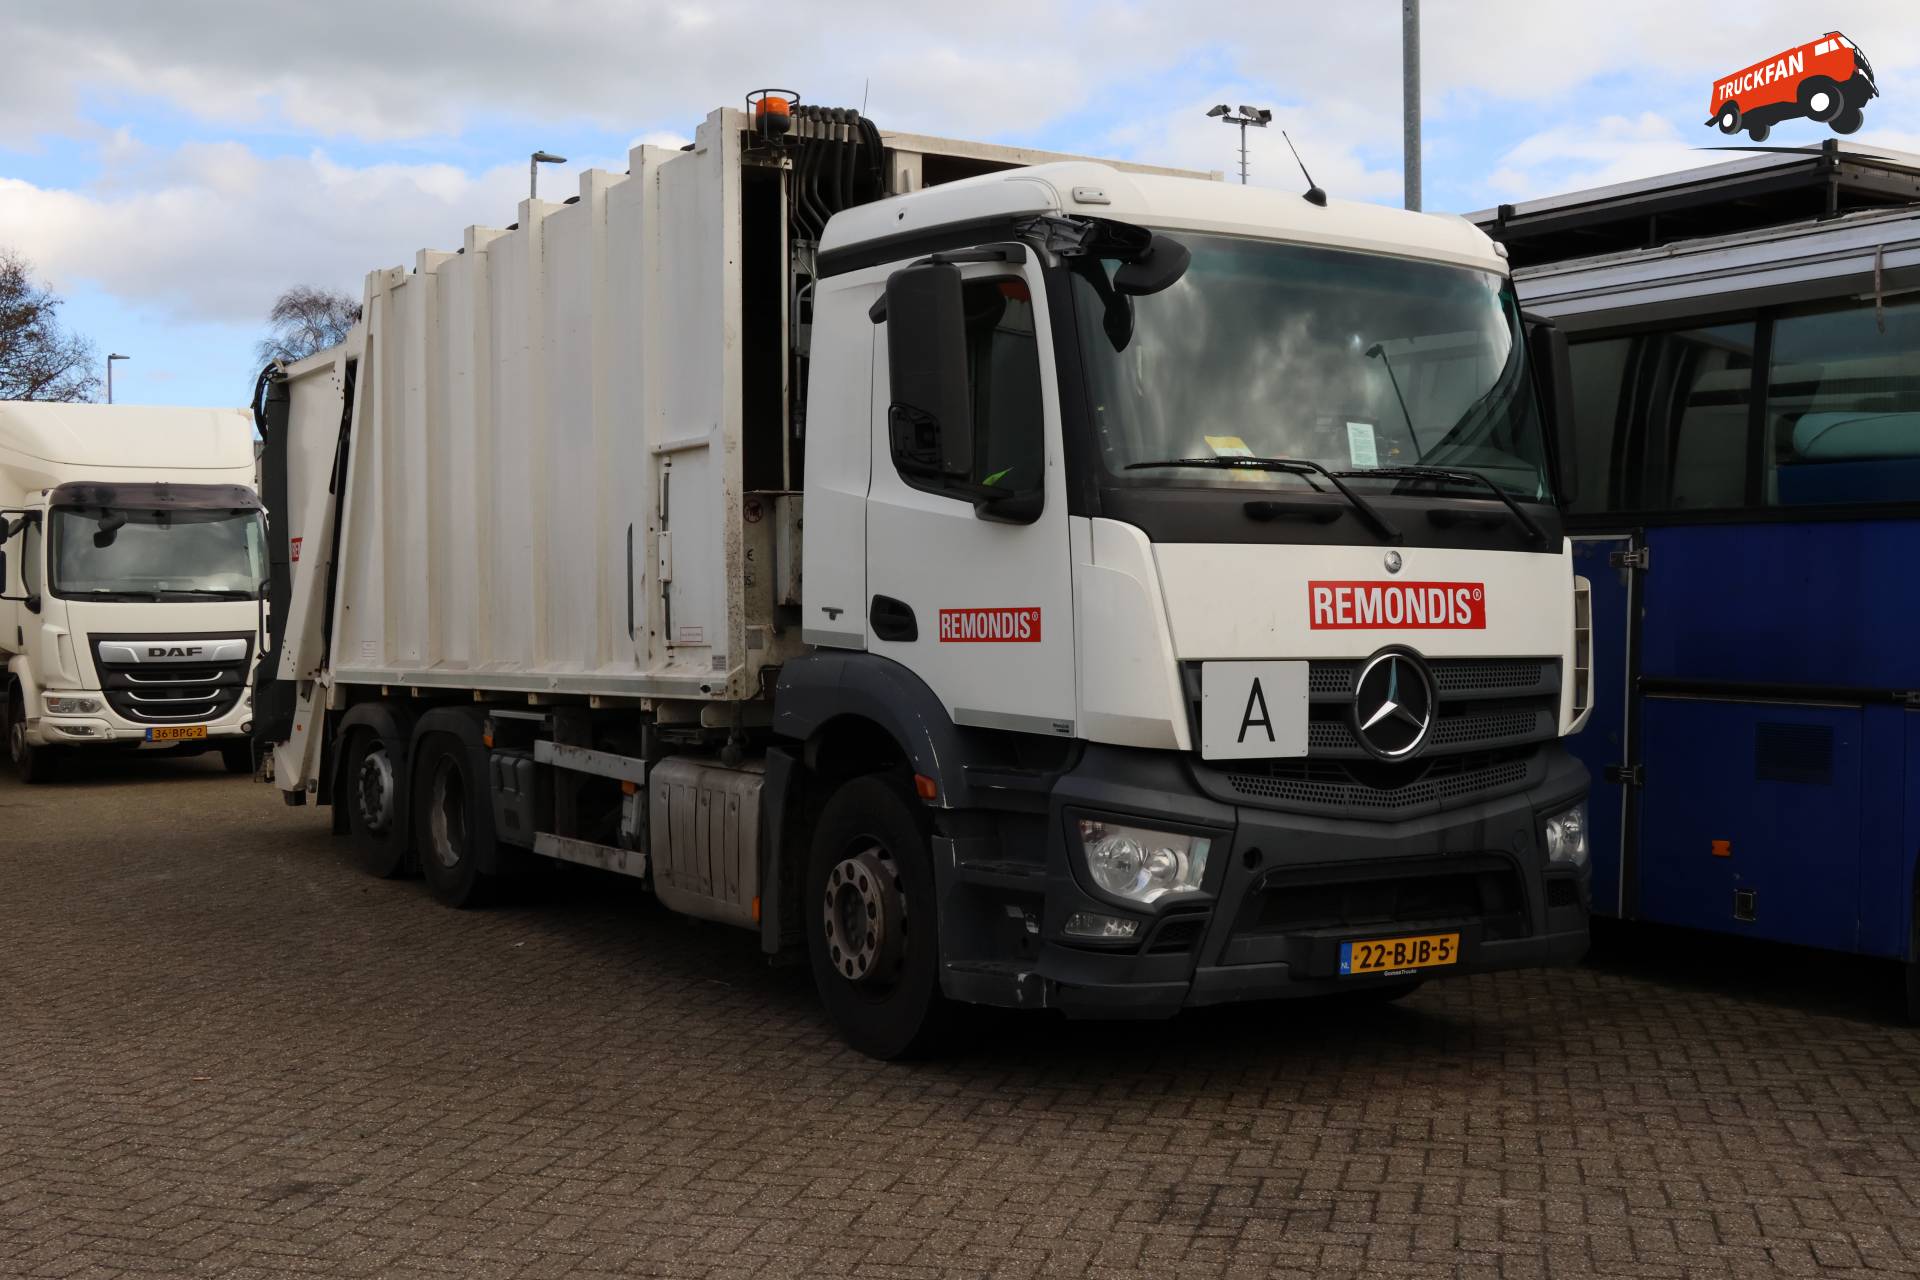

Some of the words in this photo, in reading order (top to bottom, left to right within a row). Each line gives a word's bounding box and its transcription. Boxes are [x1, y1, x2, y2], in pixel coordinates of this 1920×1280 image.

[148, 647, 203, 657] DAF
[1237, 677, 1276, 743] A
[155, 727, 203, 738] 36-BPG-2
[1359, 938, 1450, 969] 22-BJB-5
